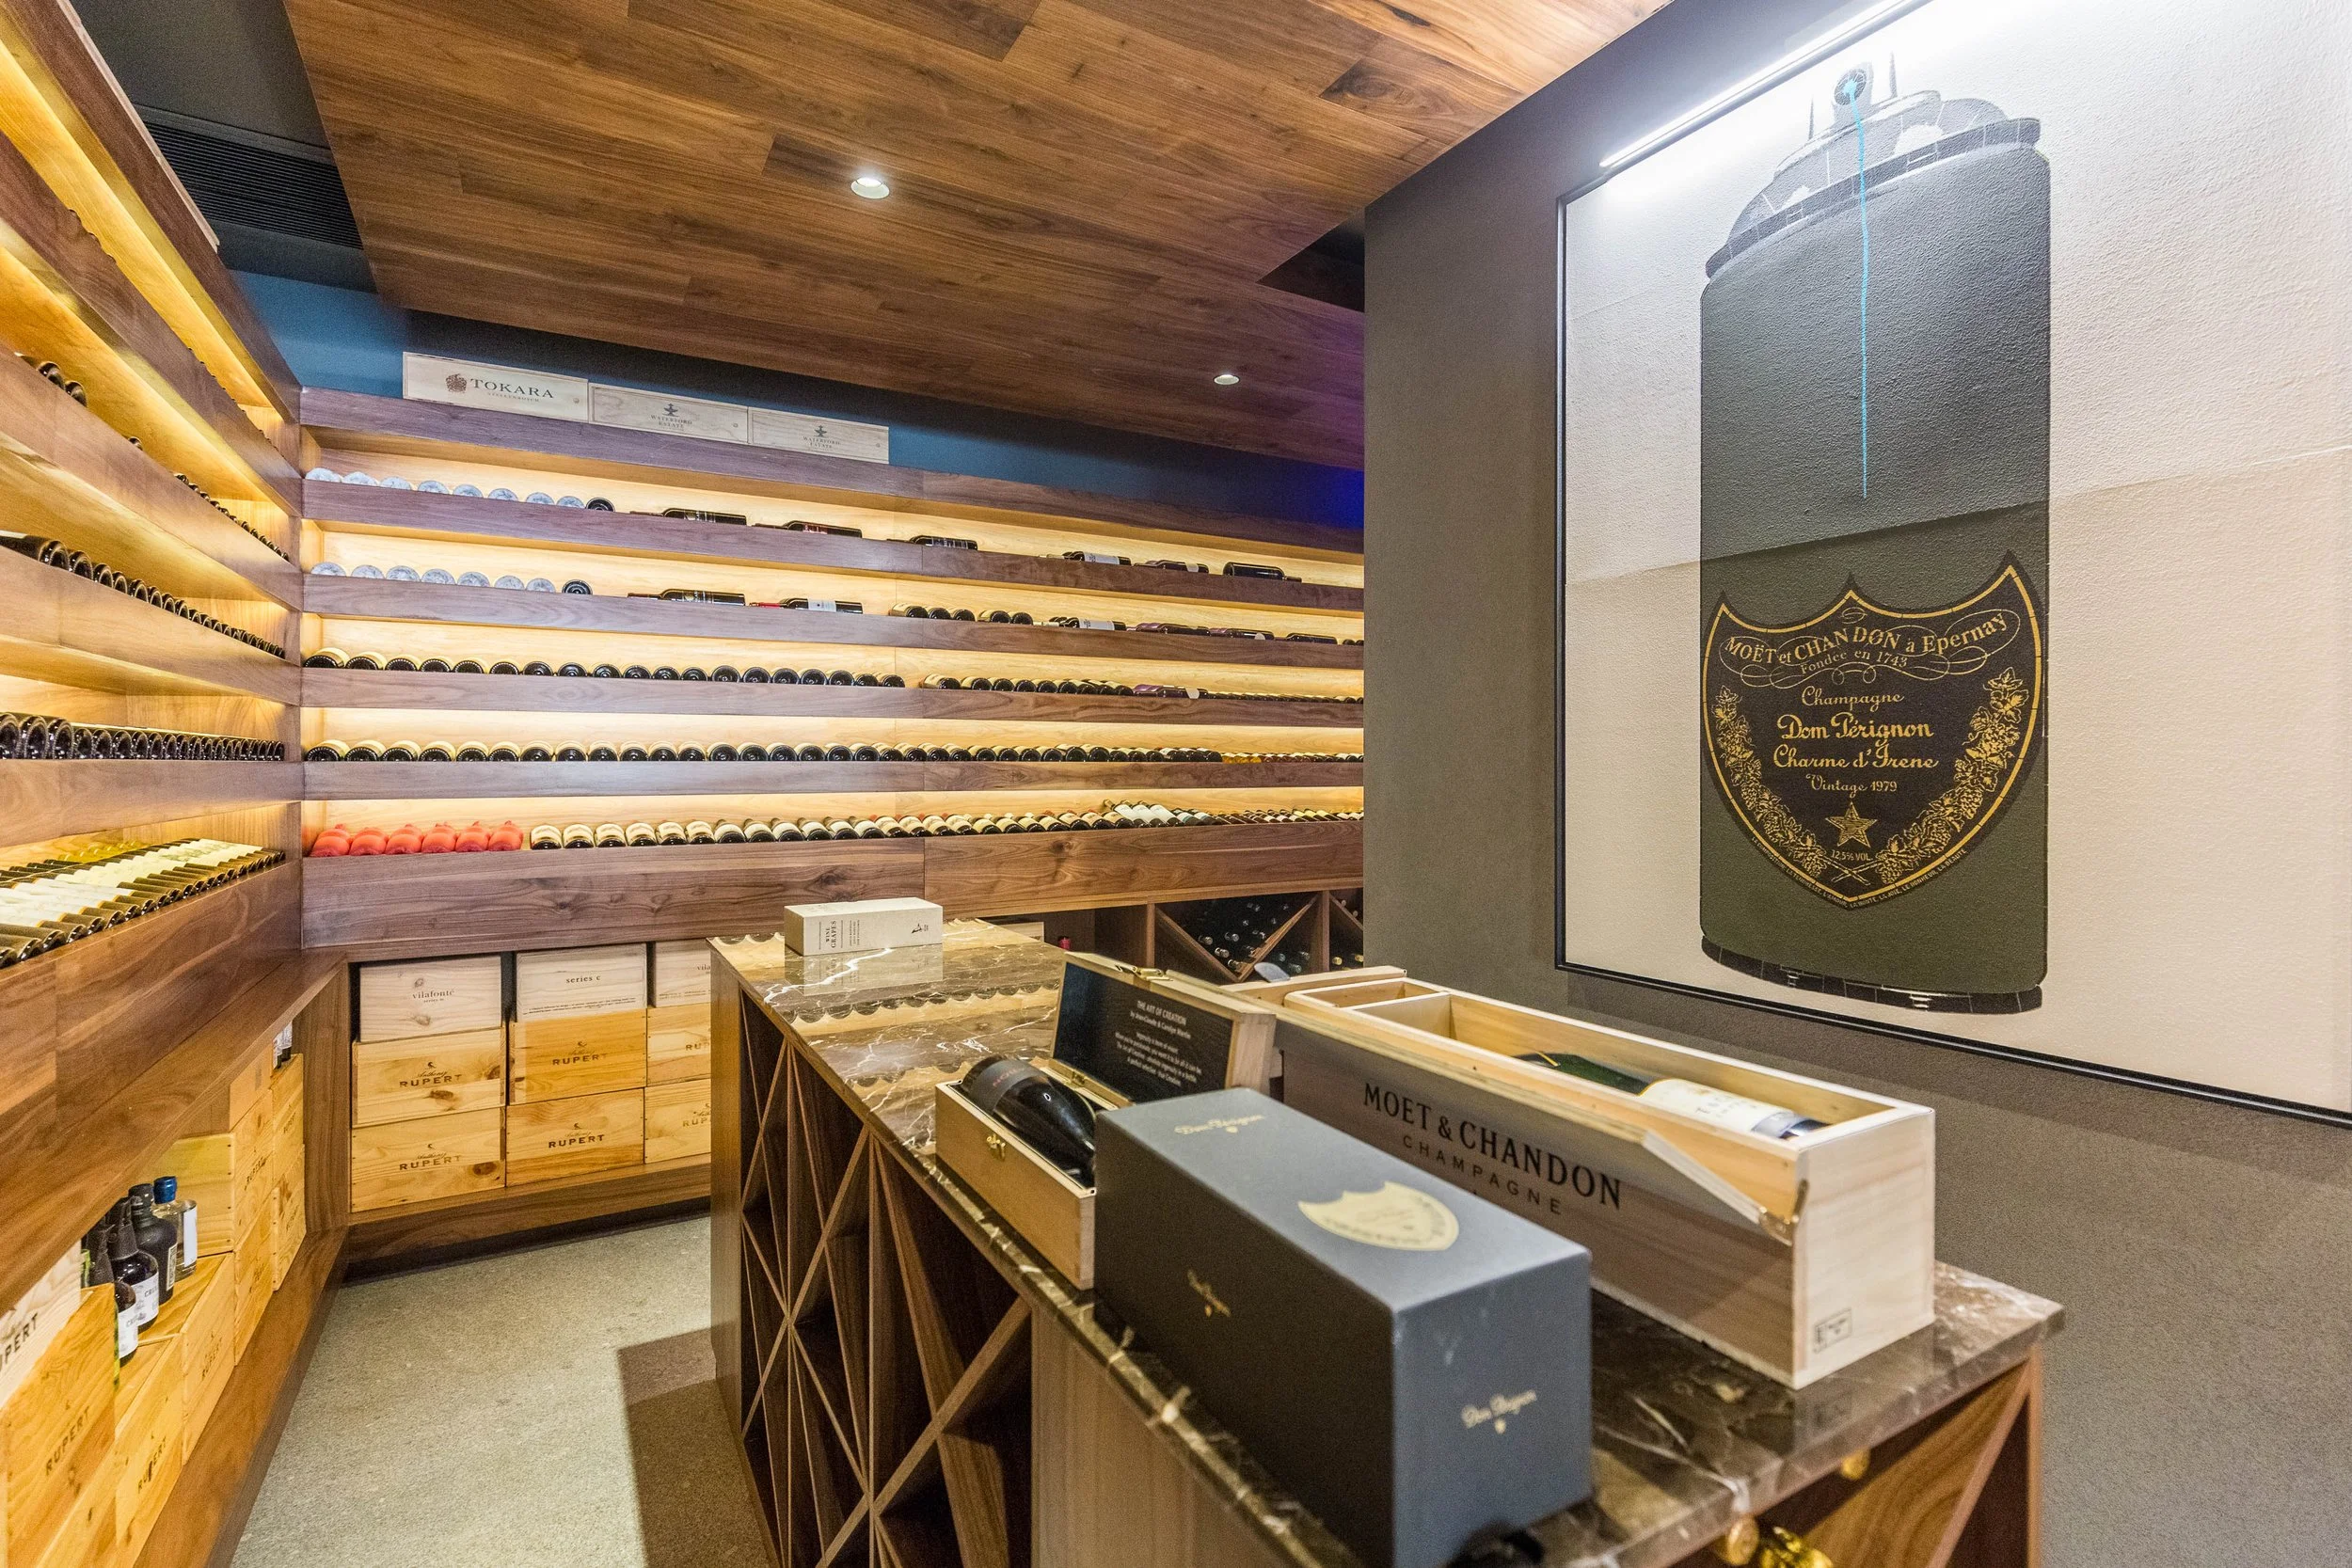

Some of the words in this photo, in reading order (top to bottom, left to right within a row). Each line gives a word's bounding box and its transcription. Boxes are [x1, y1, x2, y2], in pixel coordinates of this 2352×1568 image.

[470, 378, 554, 399] TOKARA
[1724, 636, 1777, 664] MOËT
[1778, 651, 1791, 664] et
[1922, 612, 2009, 655] Epernay
[1854, 649, 1871, 660] en
[1876, 651, 1909, 669] 1743
[1801, 685, 1906, 713] Champagne
[1776, 714, 1831, 740] Dom
[1830, 711, 1936, 745] Pérignon
[1773, 743, 1851, 768] Charme
[1805, 773, 1869, 800] Vintage
[1870, 780, 1899, 793] 1979
[565, 974, 593, 985] series
[685, 1041, 710, 1052] RUP
[552, 1053, 608, 1066] RUPERT
[399, 1073, 463, 1088] RUPERT
[682, 1117, 707, 1128] RUP
[548, 1133, 605, 1148] RUPERT
[1363, 1083, 1432, 1130] MOET
[1438, 1116, 1454, 1142] &
[1459, 1120, 1622, 1210] CHANDON
[399, 1154, 462, 1171] RUPERT
[1403, 1135, 1562, 1215] CHAMPAGNE
[0, 1312, 40, 1372] PERT
[46, 1405, 90, 1477] RUPERT
[138, 1435, 167, 1495] RUERT
